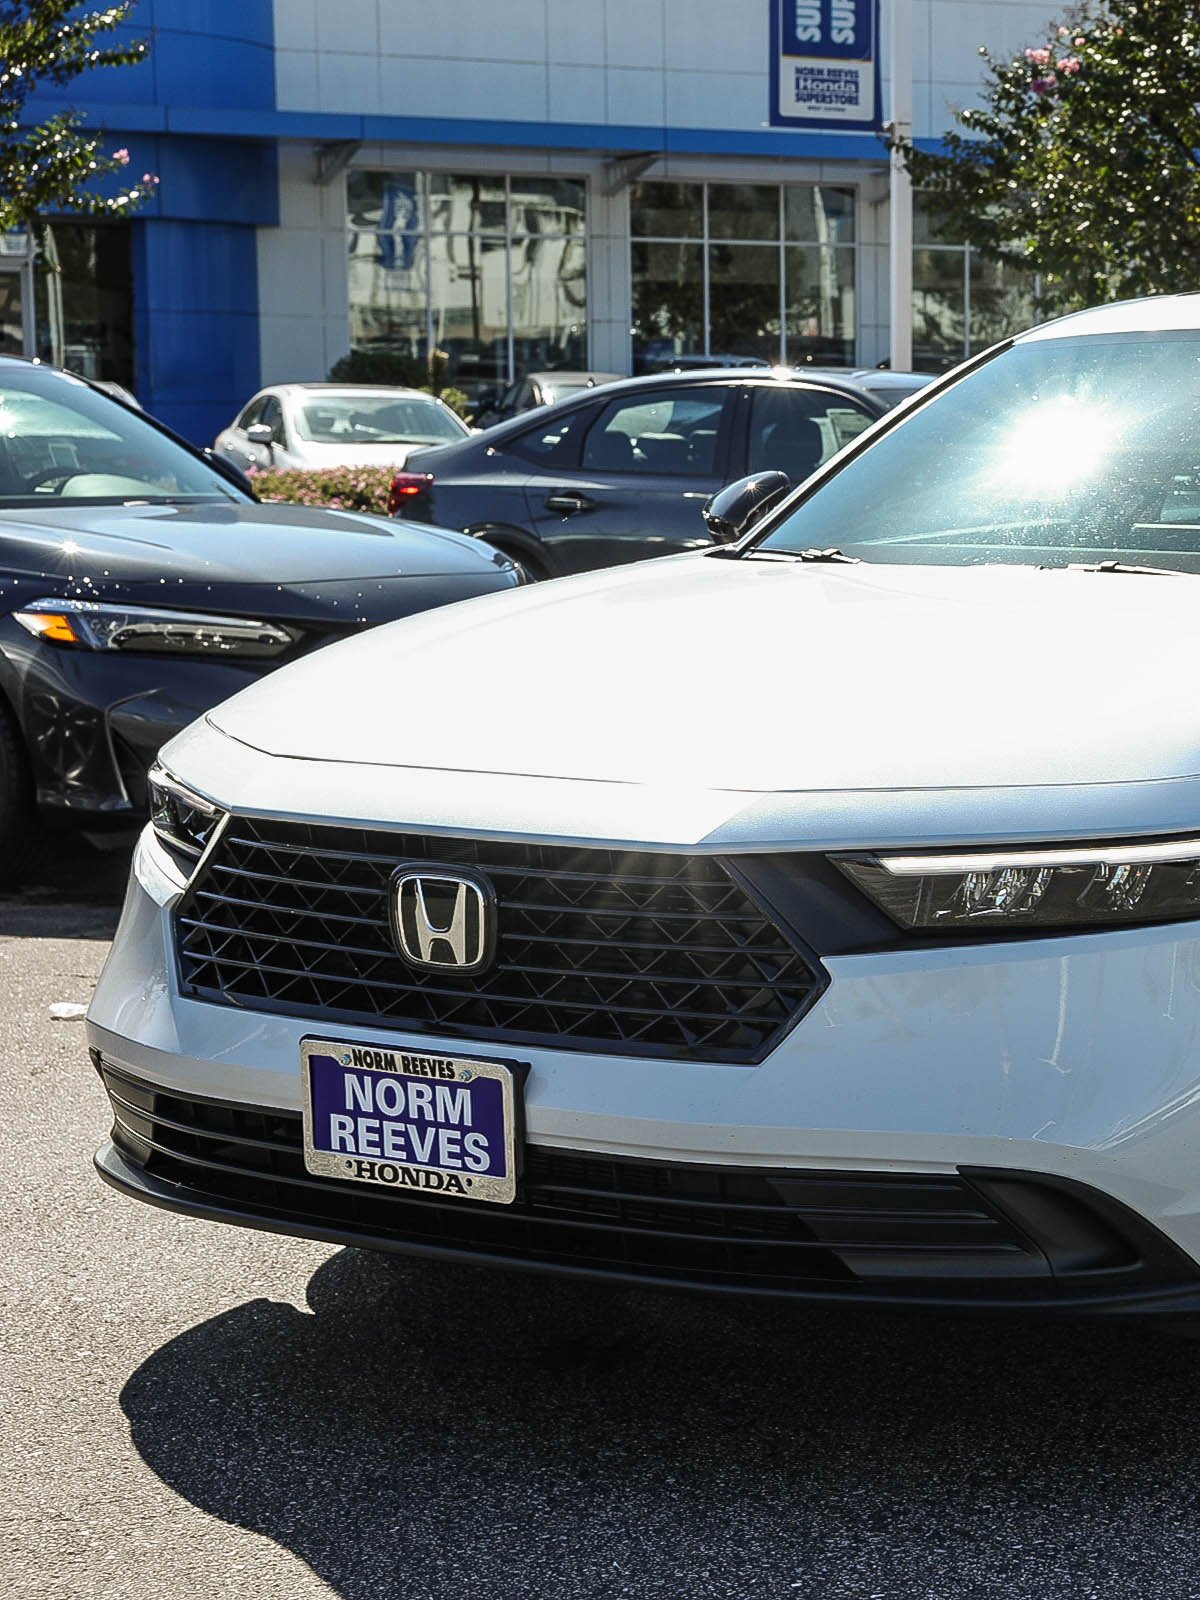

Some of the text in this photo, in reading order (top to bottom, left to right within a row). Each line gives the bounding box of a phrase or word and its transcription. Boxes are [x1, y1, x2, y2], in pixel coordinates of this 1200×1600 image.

[795, 92, 860, 106] SUPERSTORE
[798, 77, 857, 92] Honda
[351, 1048, 456, 1080] NORM REEVES
[344, 1073, 473, 1127] NORM
[329, 1113, 492, 1172] REEVES
[353, 1159, 468, 1195] HONDA
